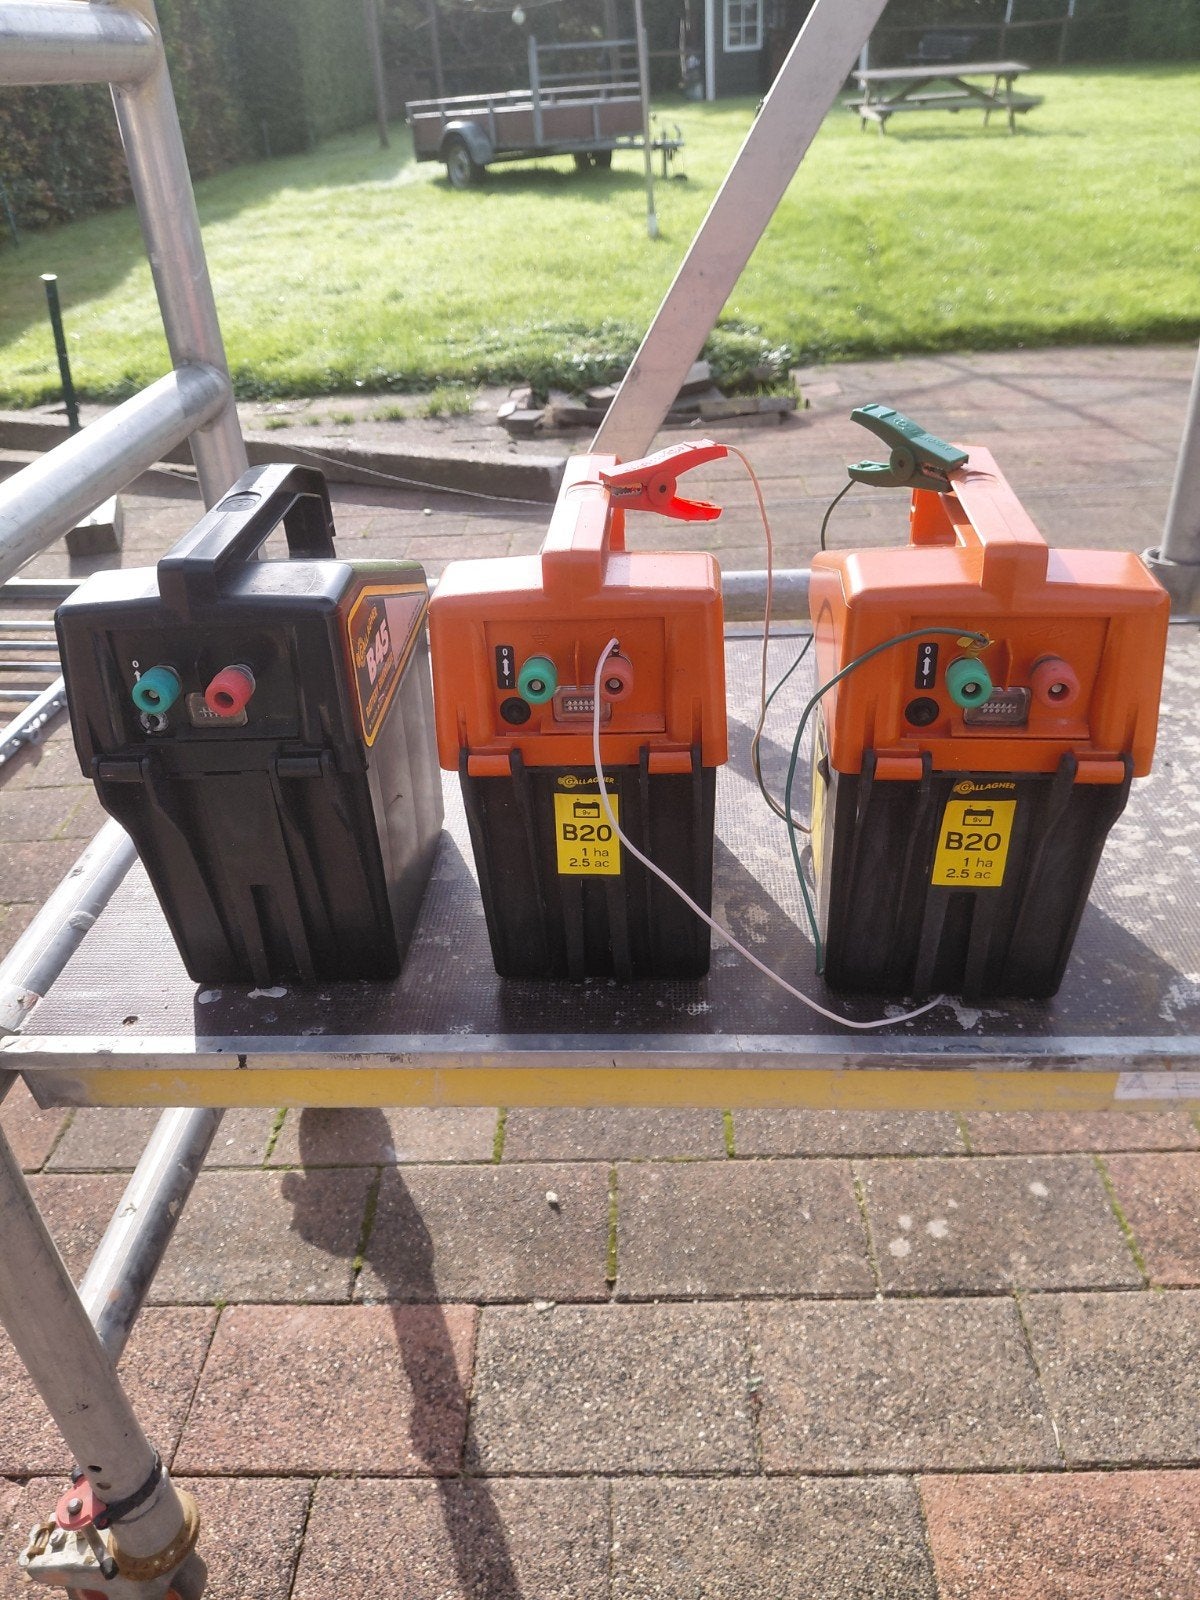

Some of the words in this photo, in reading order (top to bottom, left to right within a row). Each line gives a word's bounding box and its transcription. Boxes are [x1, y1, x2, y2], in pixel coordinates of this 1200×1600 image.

[957, 781, 1016, 794] GALLAGHER
[562, 823, 612, 842] B20
[945, 831, 1002, 852] B20
[581, 848, 587, 857] 1
[593, 847, 609, 857] ha
[569, 858, 590, 867] 2.5
[594, 860, 610, 868] ac
[963, 857, 970, 867] 1
[976, 857, 993, 867] ha
[946, 868, 970, 879] 2.5
[974, 871, 991, 879] ac
